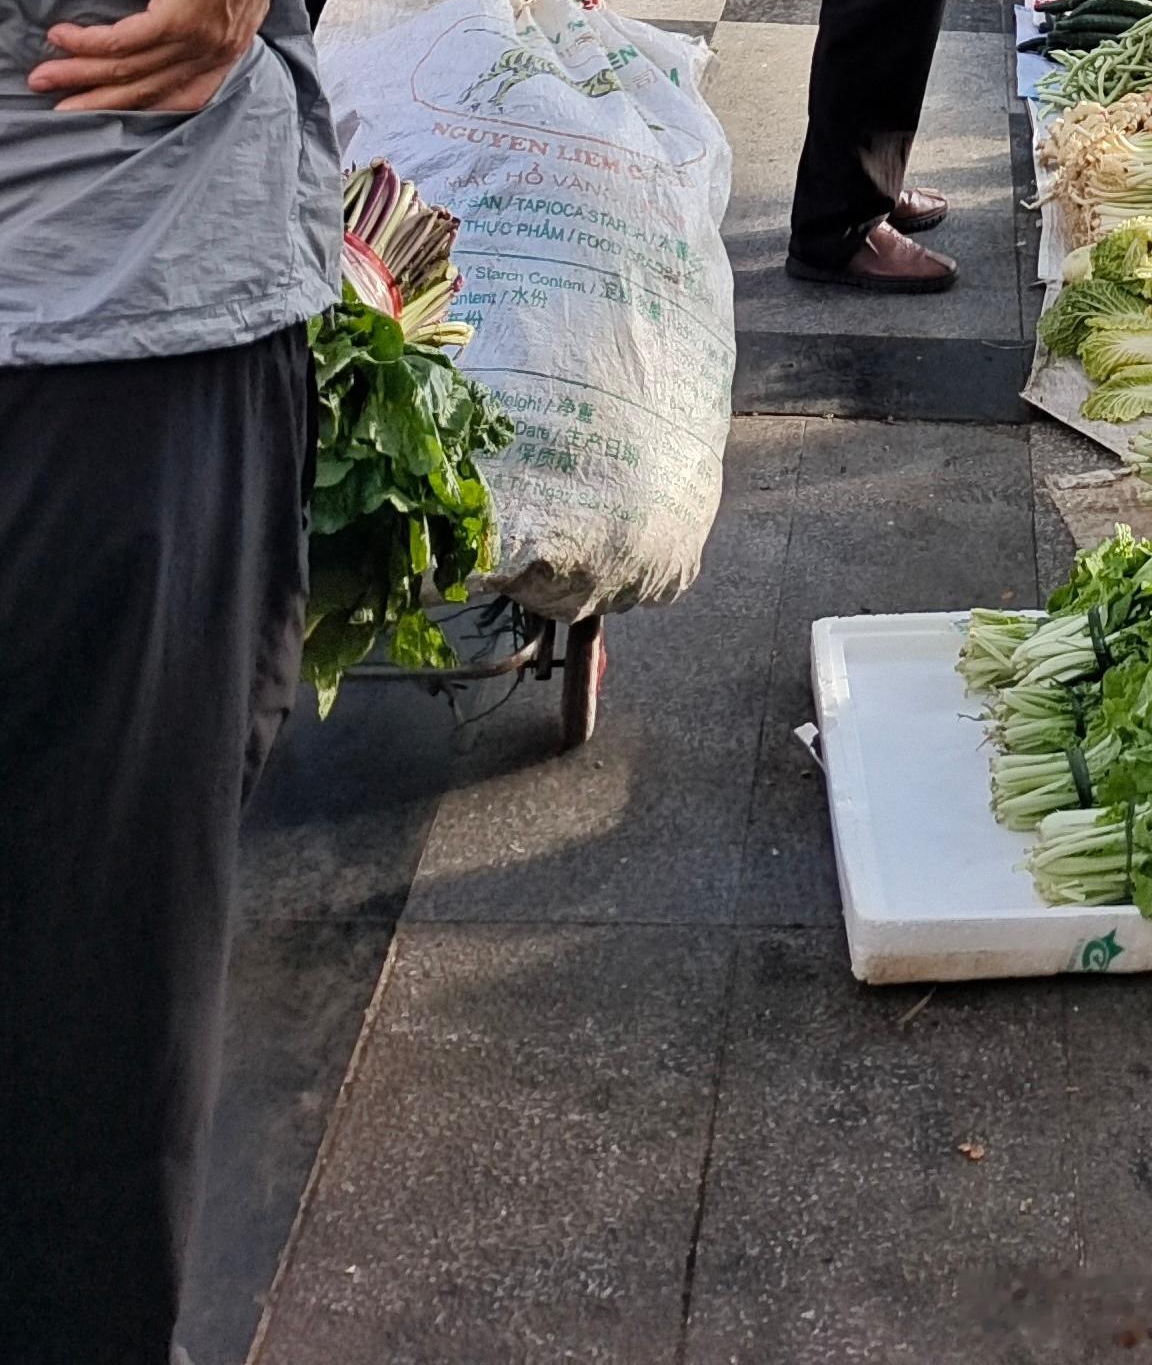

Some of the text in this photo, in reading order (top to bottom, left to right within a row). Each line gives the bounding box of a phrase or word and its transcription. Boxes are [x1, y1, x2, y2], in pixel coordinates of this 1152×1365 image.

[475, 266, 525, 282] Starch
[528, 271, 588, 294] Content
[449, 290, 498, 307] ontent
